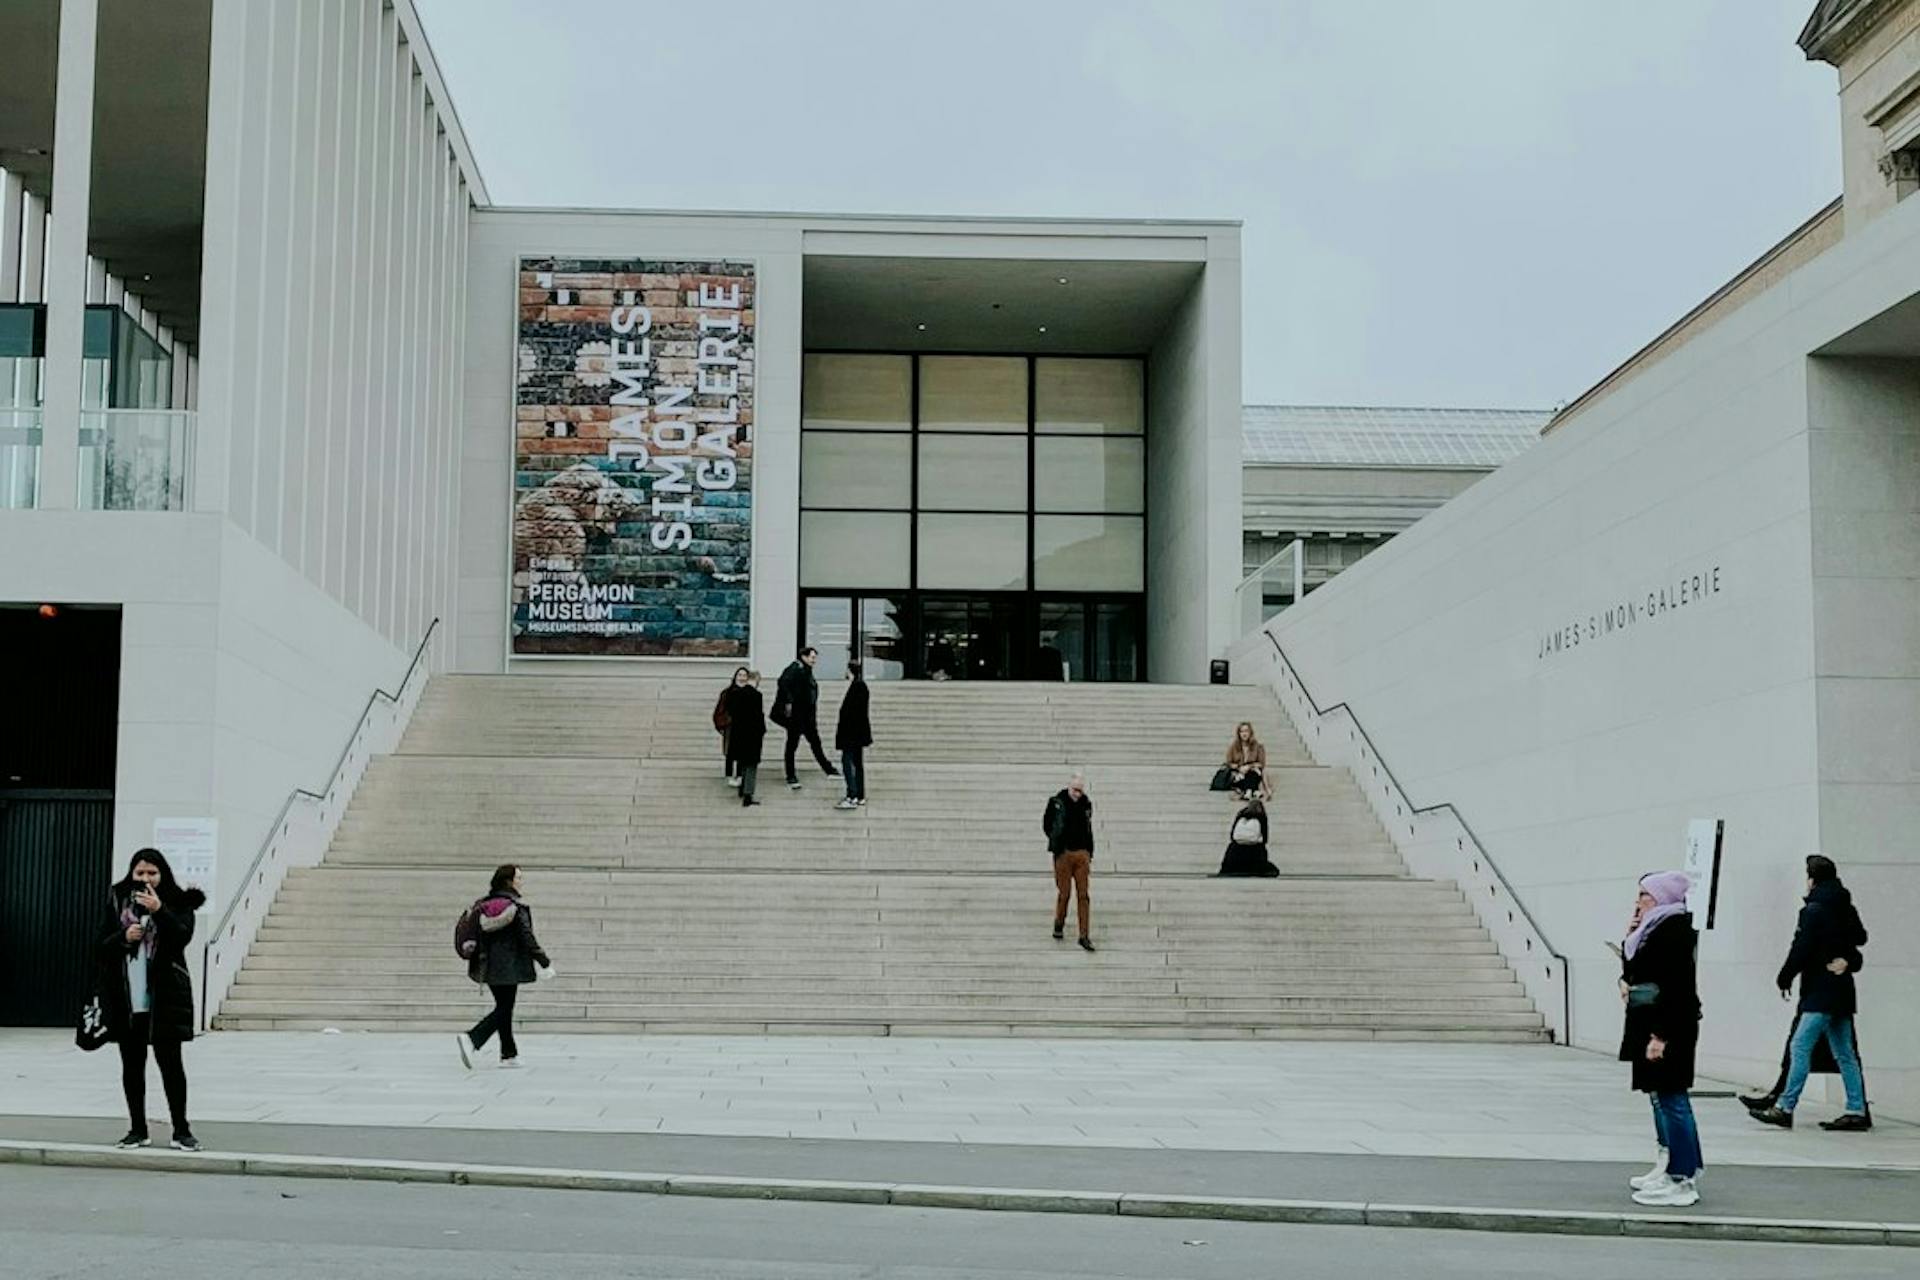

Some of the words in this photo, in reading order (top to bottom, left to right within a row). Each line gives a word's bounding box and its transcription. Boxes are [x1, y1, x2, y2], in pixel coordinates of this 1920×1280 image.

[609, 306, 651, 471] JAMES
[696, 282, 740, 490] GALERIE
[651, 386, 697, 551] SIMON
[528, 584, 634, 601] PERGAMON
[528, 602, 613, 620] MUSEUM
[528, 621, 606, 632] MUSEUMSINSEL
[1538, 566, 1721, 659] JAMES-SIMON-GALERIE
